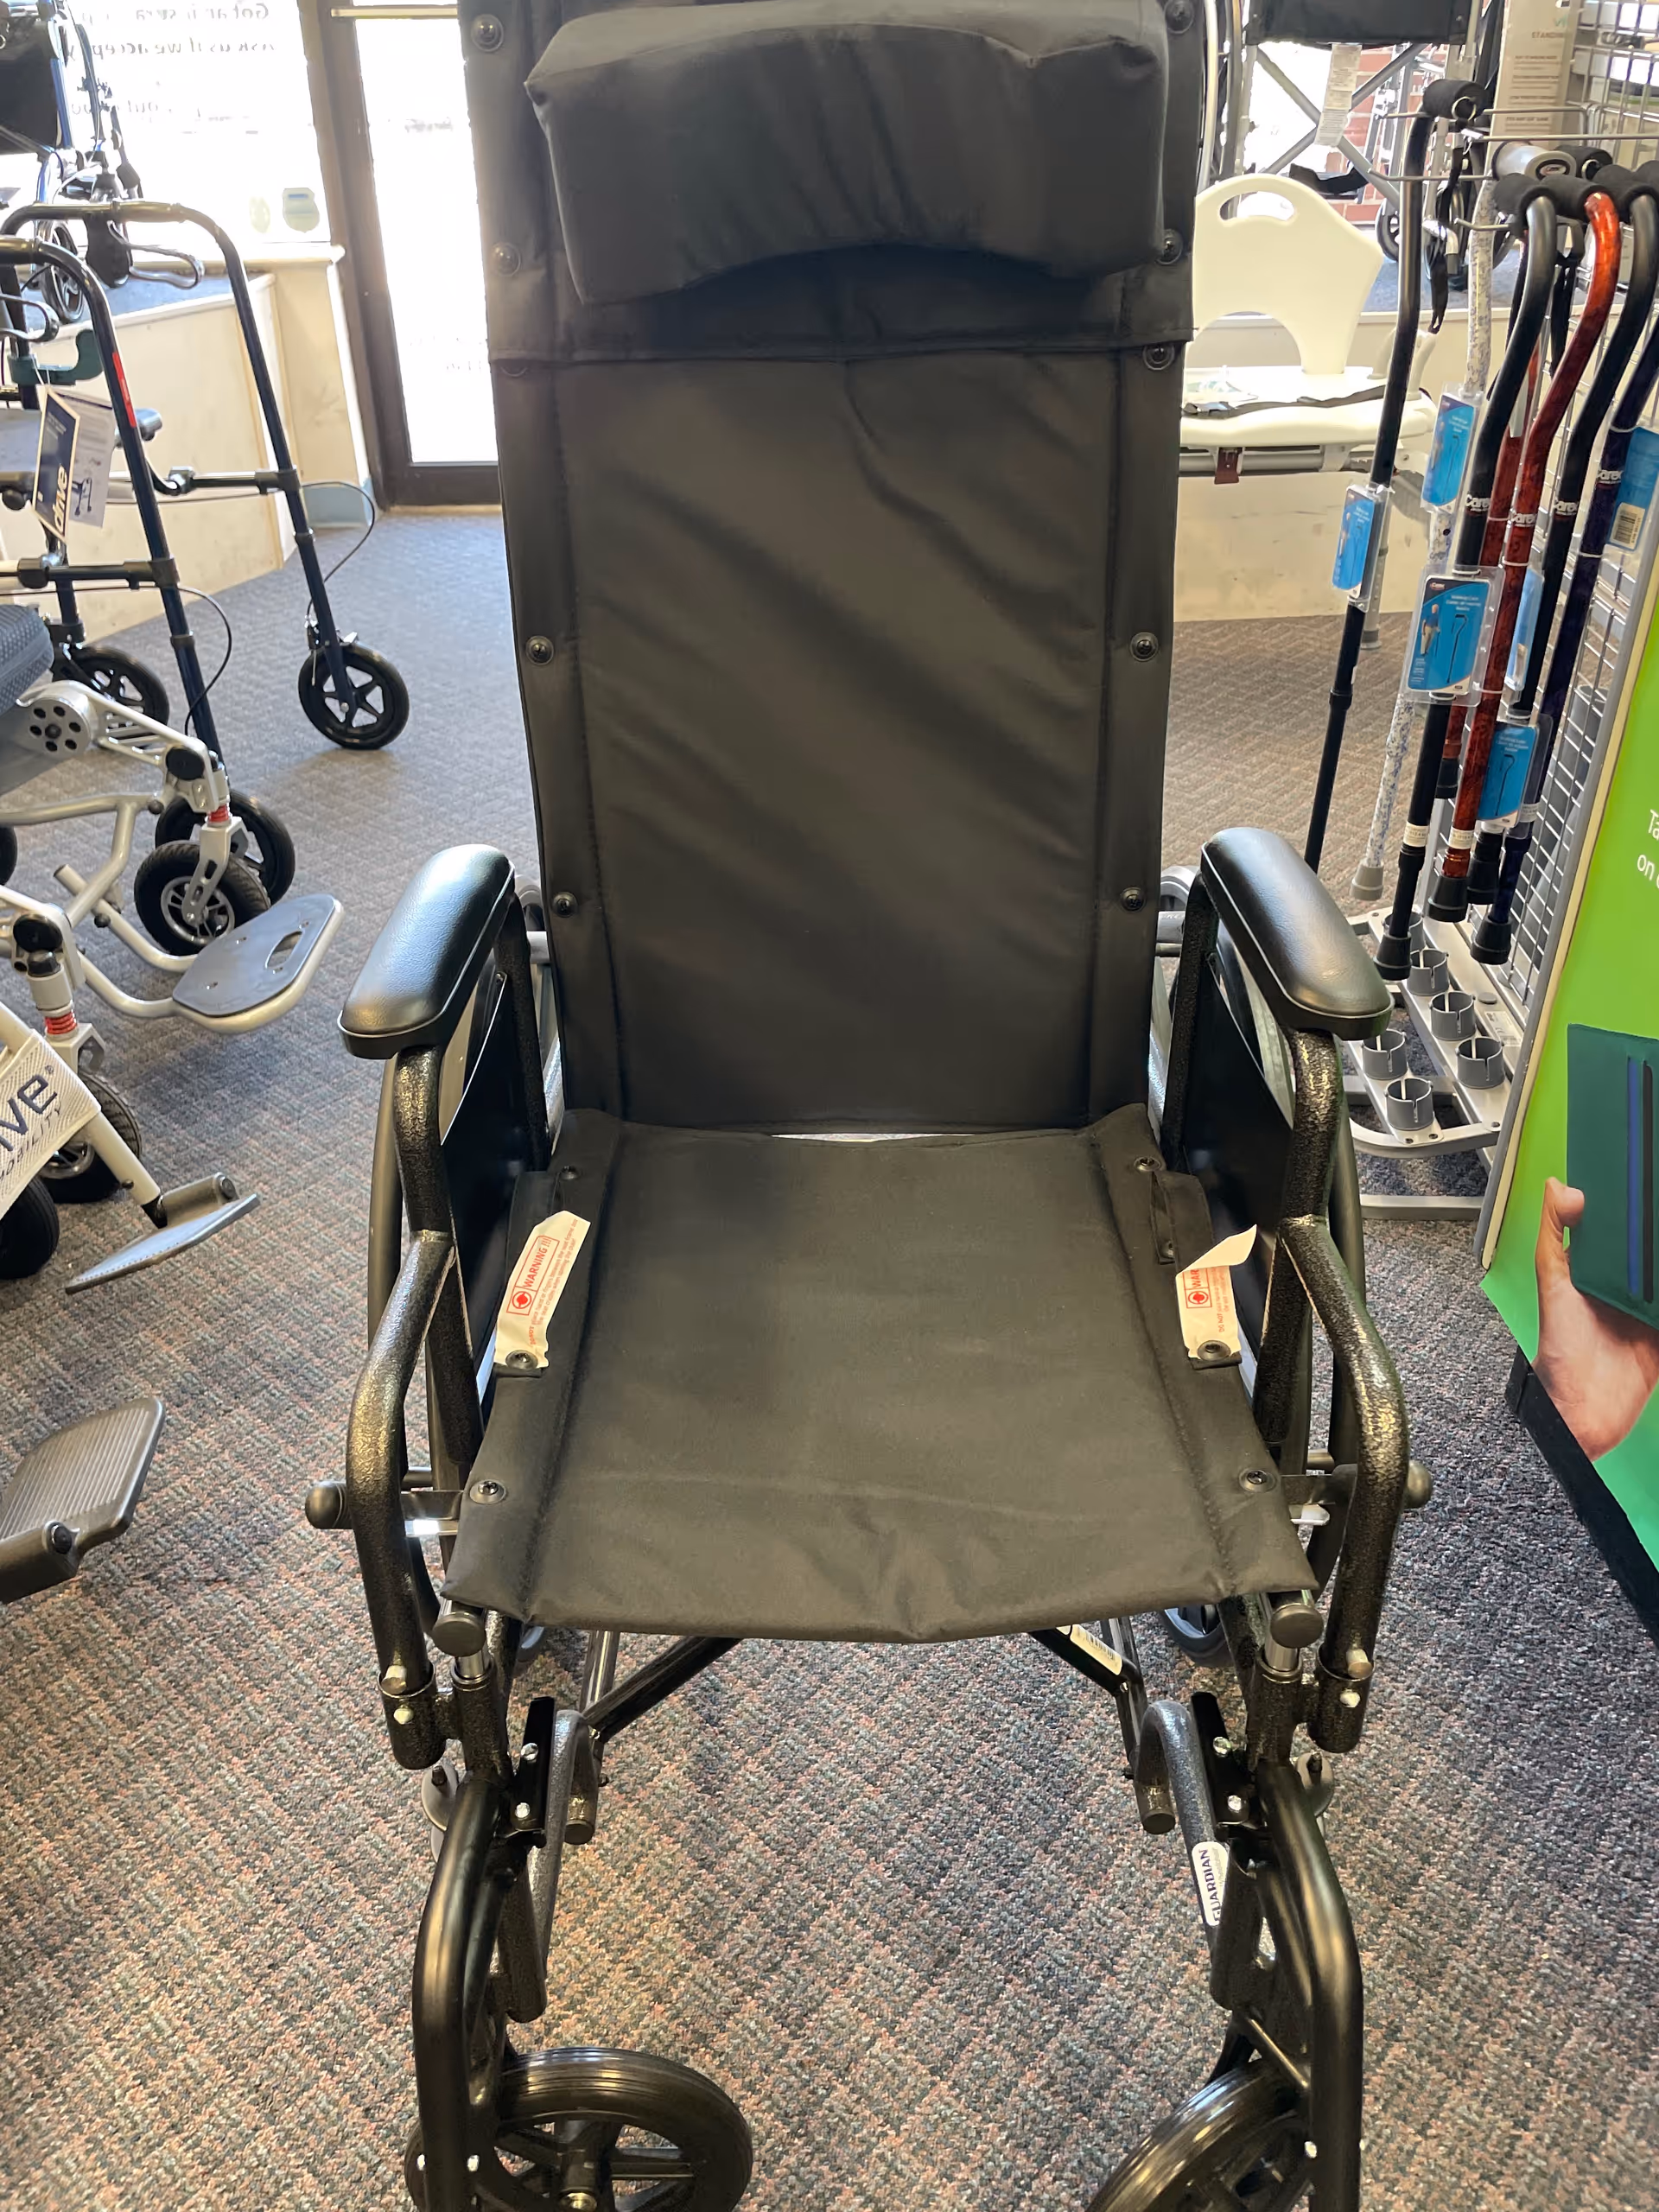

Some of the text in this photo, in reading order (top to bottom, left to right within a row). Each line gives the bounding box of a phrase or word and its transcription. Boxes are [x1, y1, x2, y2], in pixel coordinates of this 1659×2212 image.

[52, 465, 67, 533] drive
[1637, 854, 1656, 880] on
[523, 1248, 548, 1287] WARNING
